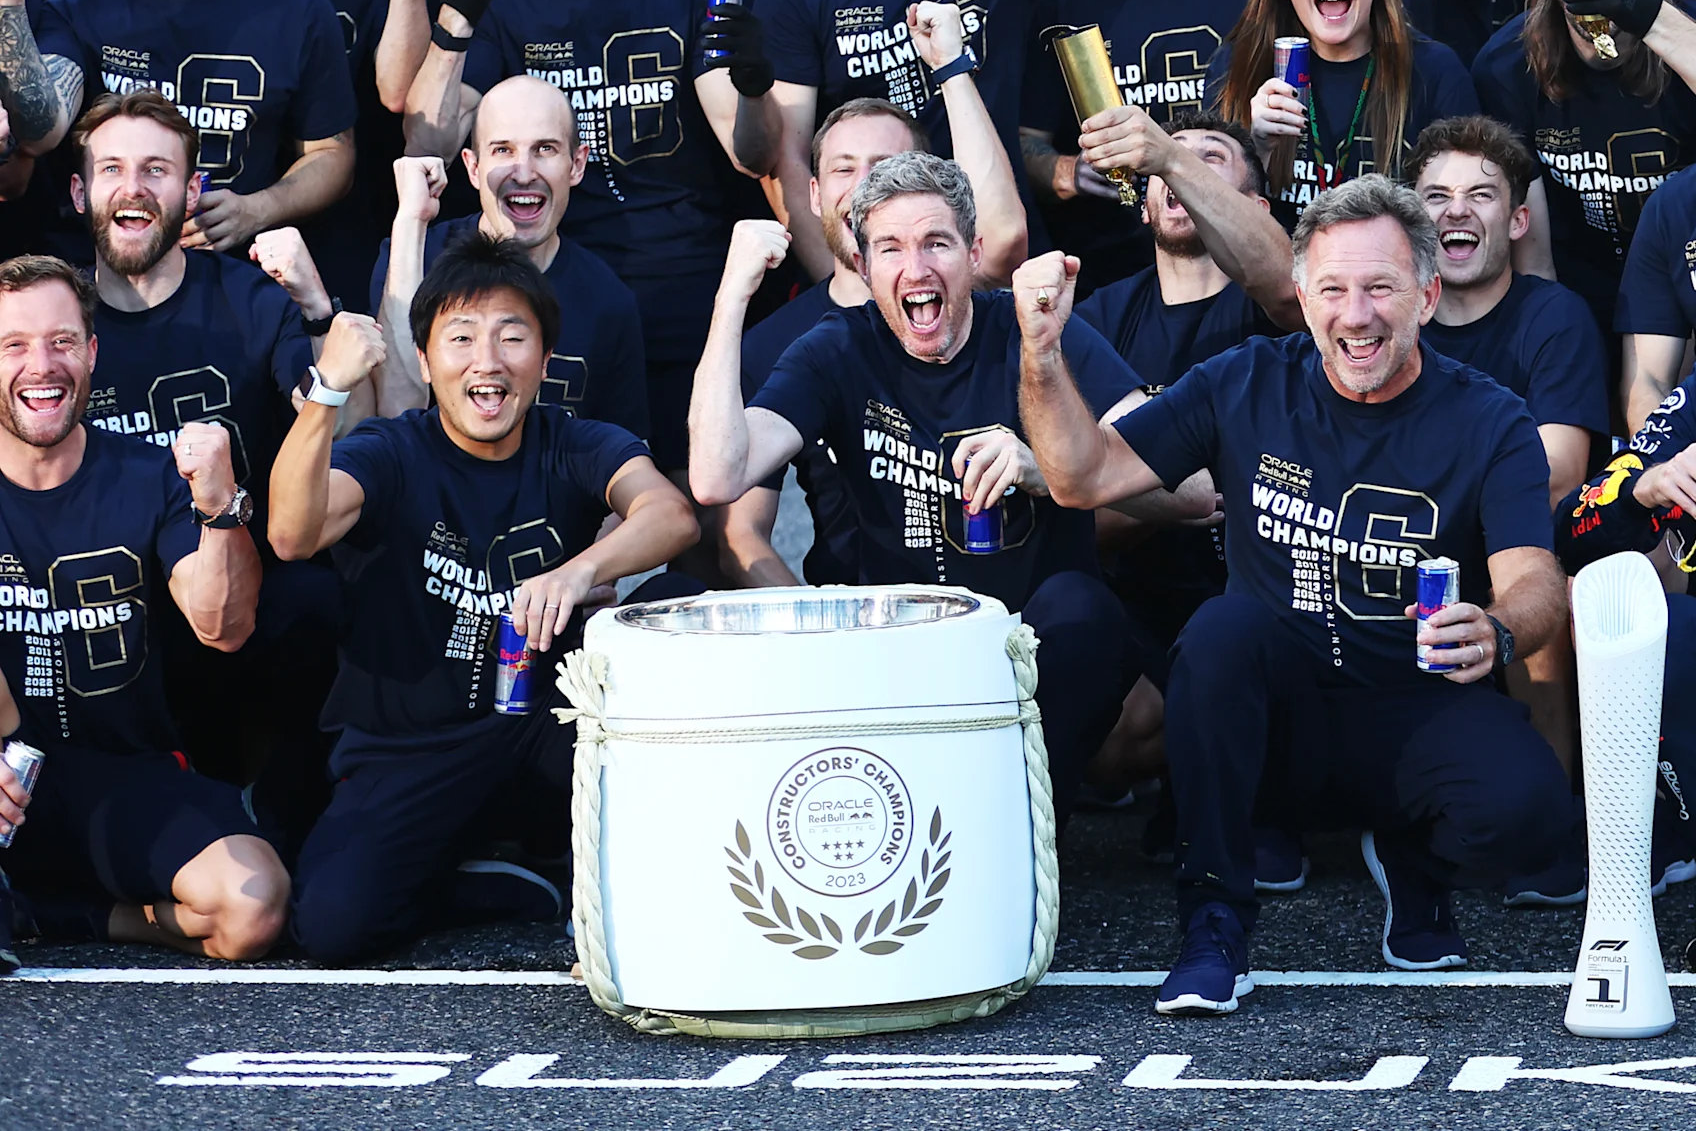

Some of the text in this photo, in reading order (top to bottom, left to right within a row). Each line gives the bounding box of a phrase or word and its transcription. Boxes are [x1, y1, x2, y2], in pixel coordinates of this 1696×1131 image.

[834, 6, 885, 17] ORACLE
[836, 22, 907, 57] WORLD
[524, 41, 575, 52] ORACLE
[101, 45, 151, 62] ORACLE
[526, 65, 602, 91] WORLD
[569, 80, 674, 110] AMPIONS
[1535, 127, 1581, 138] ORACLE
[1538, 150, 1607, 172] WORLD
[864, 429, 937, 470] WORLD
[1261, 453, 1314, 479] ORACLE
[1255, 473, 1309, 498] RACING
[1252, 482, 1335, 532] WORLD
[1256, 514, 1417, 568] CHAMPIONS
[1291, 548, 1319, 561] 2010
[423, 549, 487, 592] WORLD
[1295, 560, 1320, 570] 2011
[1293, 569, 1320, 581] 2012
[1295, 579, 1321, 592] 2013
[1292, 588, 1322, 601] 2022
[1292, 599, 1324, 613] 2023
[25, 636, 51, 646] 2010
[28, 646, 52, 656] 2011
[26, 656, 53, 666] 2012
[27, 667, 53, 677] 2013
[25, 677, 54, 687] 2022
[25, 687, 54, 697] 2023
[808, 798, 874, 812] ORACLE
[863, 763, 905, 866] CHAMPIONS
[808, 824, 876, 834] RACING
[825, 872, 867, 889] 2023
[1587, 954, 1622, 963] Formula
[1586, 977, 1621, 1003] 1
